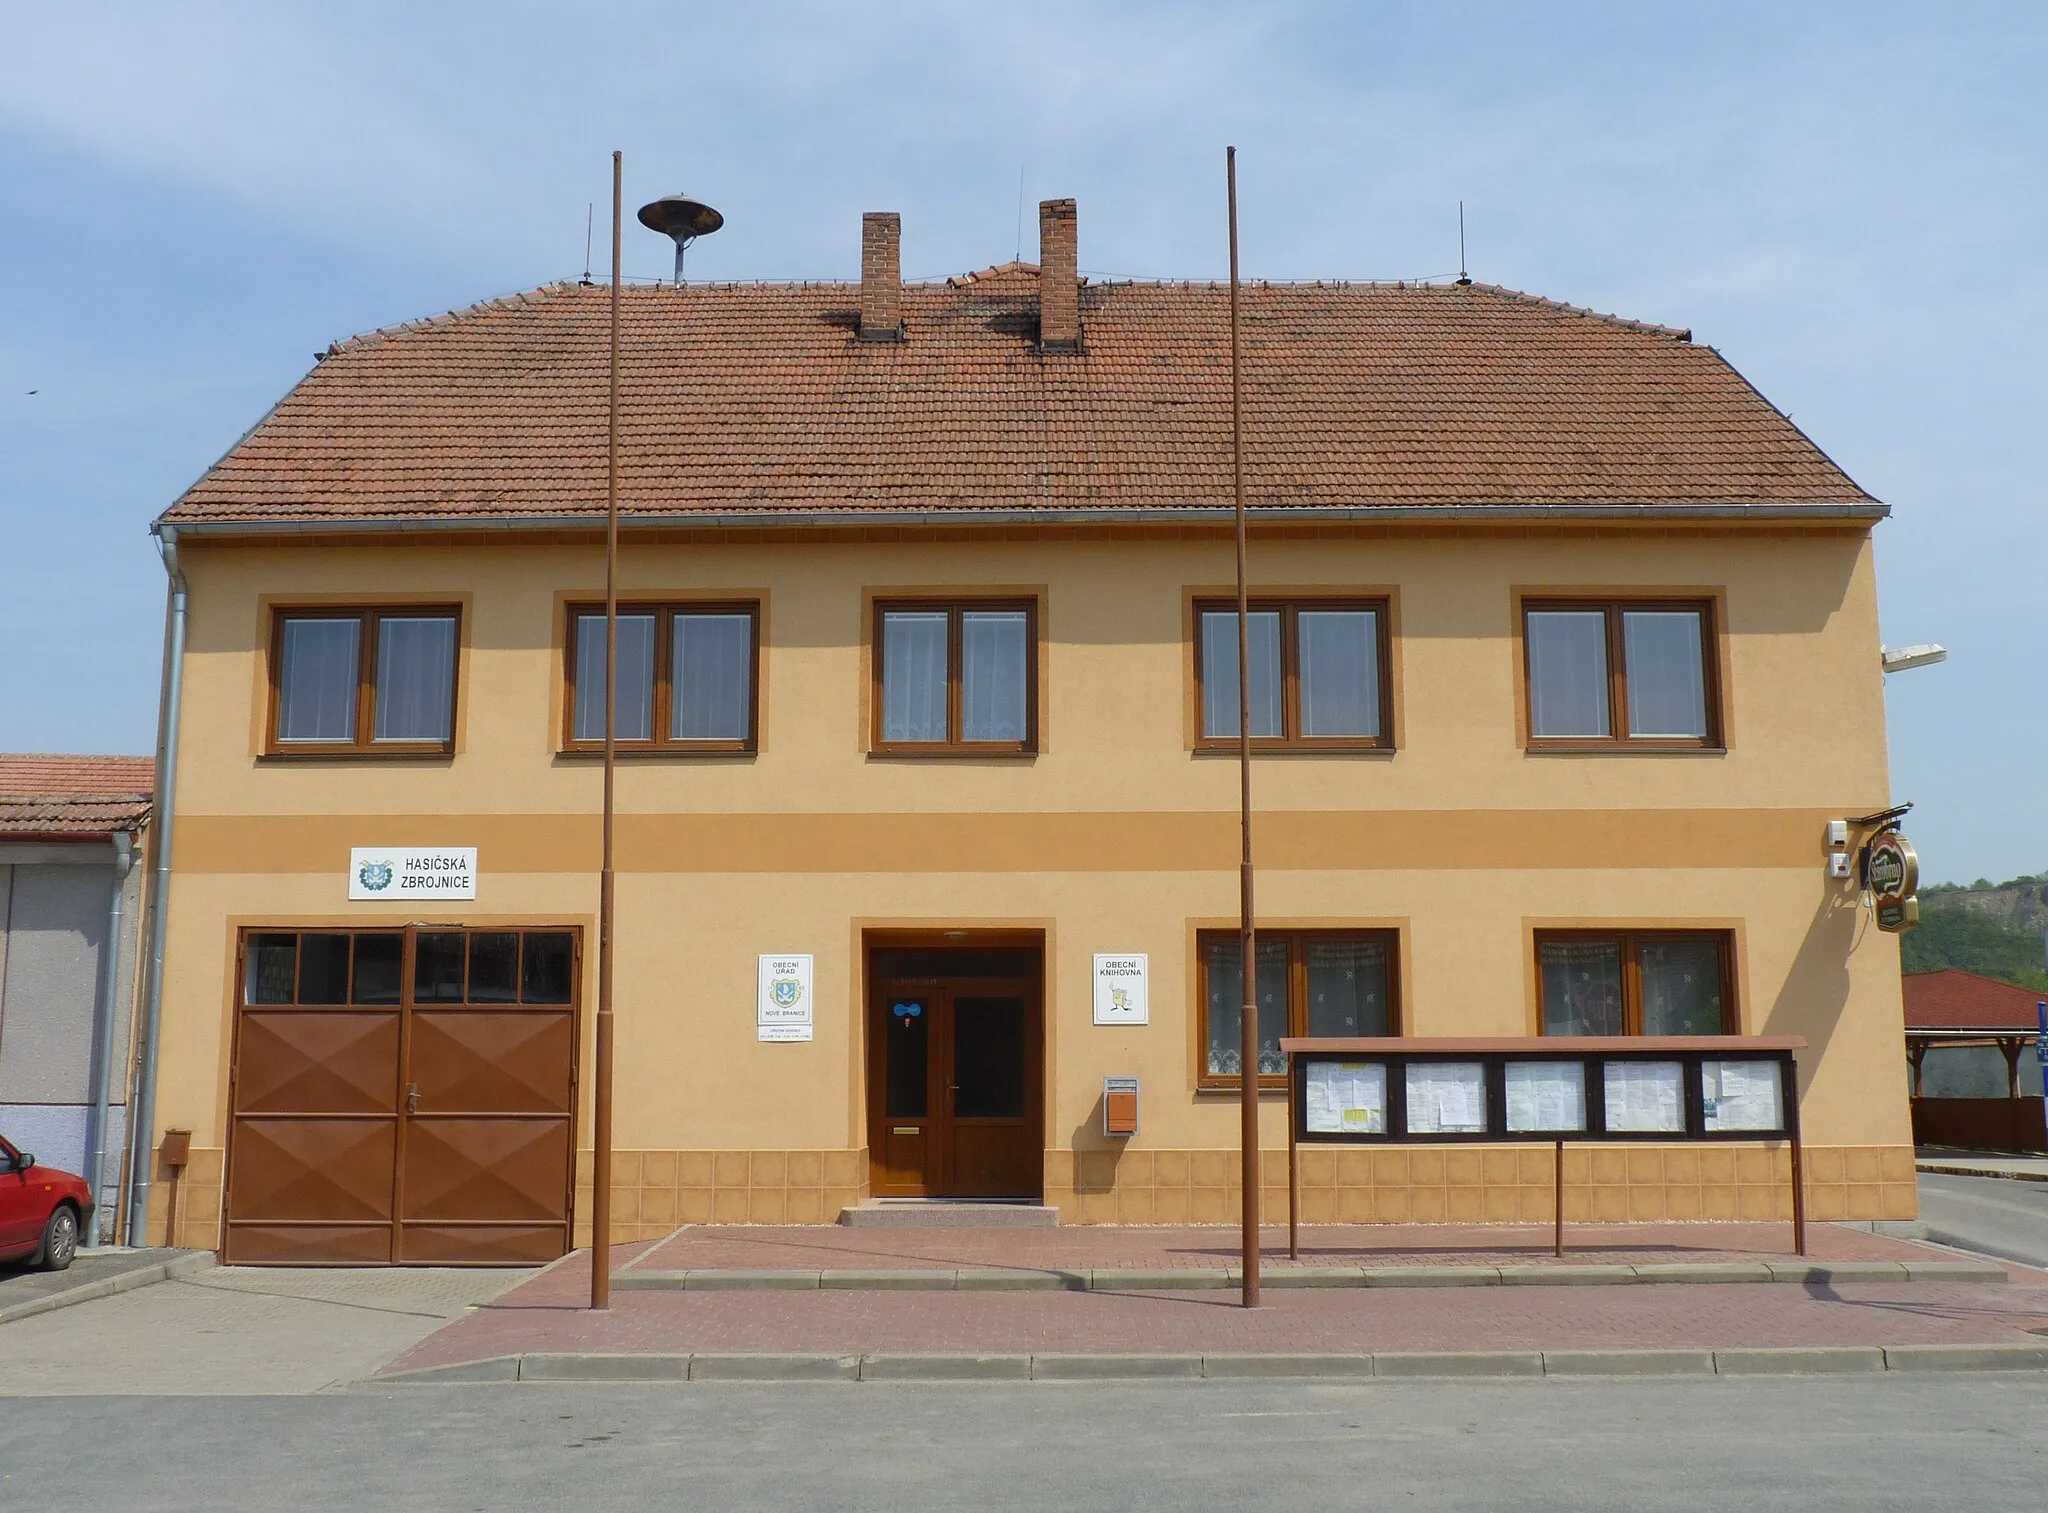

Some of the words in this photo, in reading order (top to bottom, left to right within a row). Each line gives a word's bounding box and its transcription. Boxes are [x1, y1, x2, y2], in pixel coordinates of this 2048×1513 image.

[406, 855, 467, 870] HASIČSKÁ
[401, 876, 469, 888] ZBROJNICE
[1105, 960, 1137, 969] OBECNÍ
